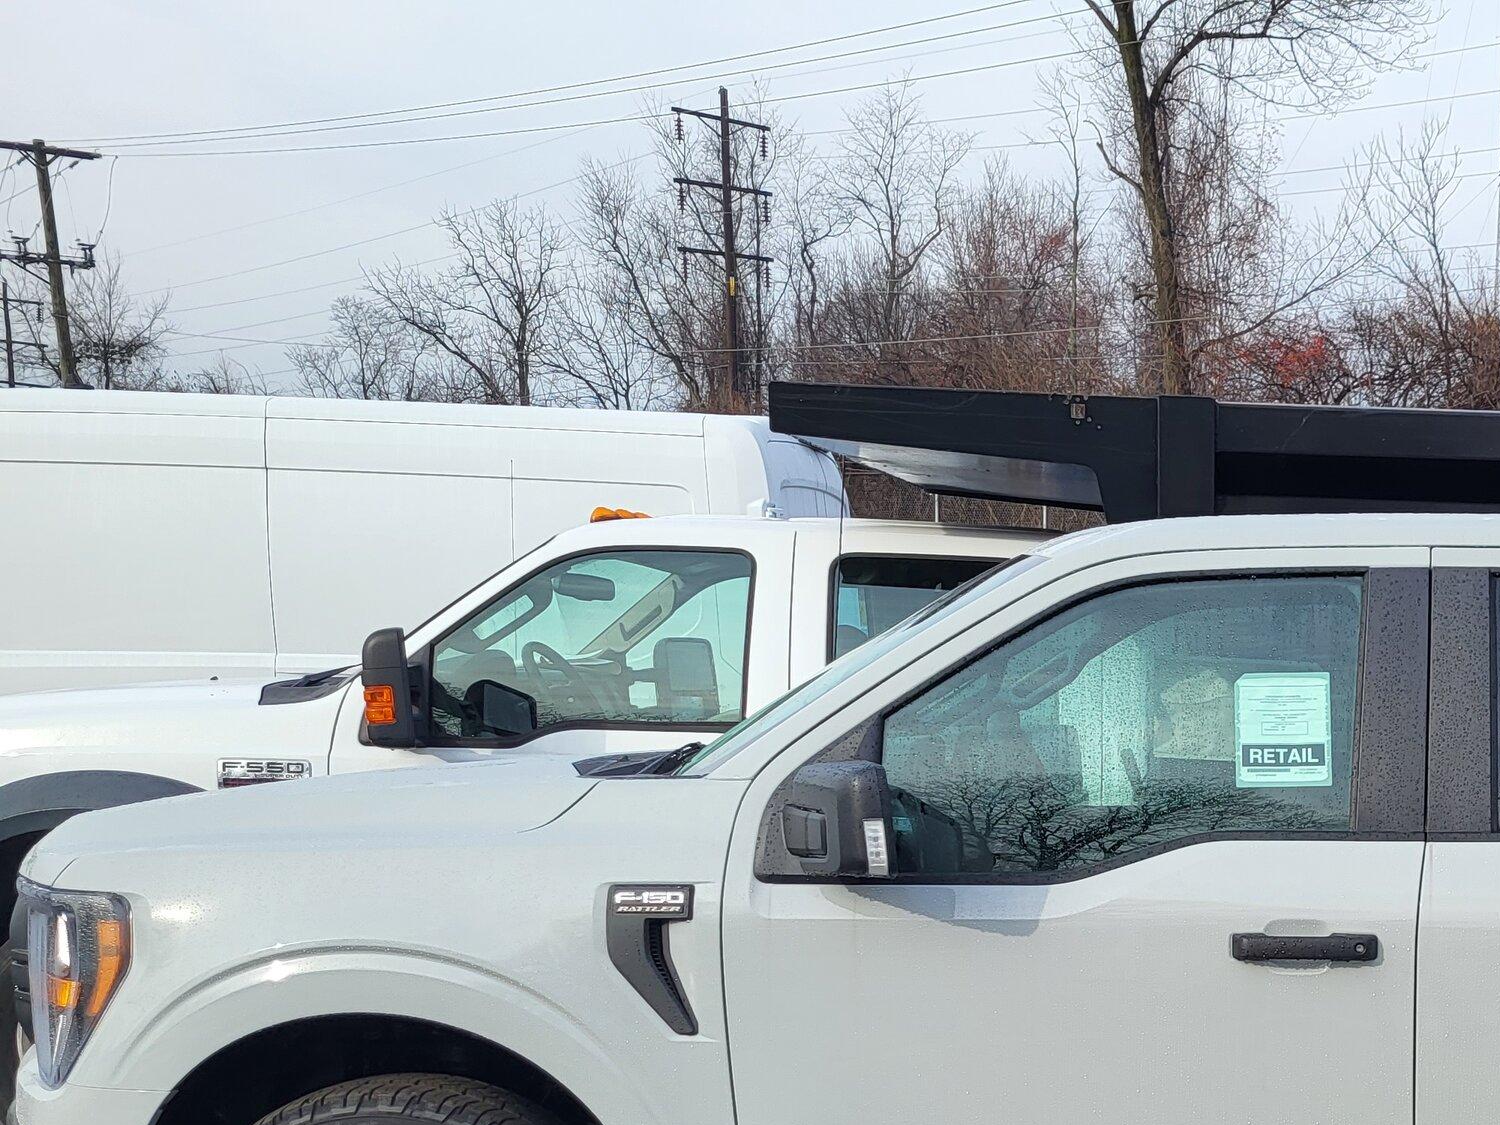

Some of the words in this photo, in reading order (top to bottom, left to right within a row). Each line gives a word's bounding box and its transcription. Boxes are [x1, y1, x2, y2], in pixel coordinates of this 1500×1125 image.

[1249, 748, 1320, 764] RETAIL
[222, 761, 304, 774] F-550
[614, 891, 685, 904] F-150
[617, 905, 681, 913] RATTLER
